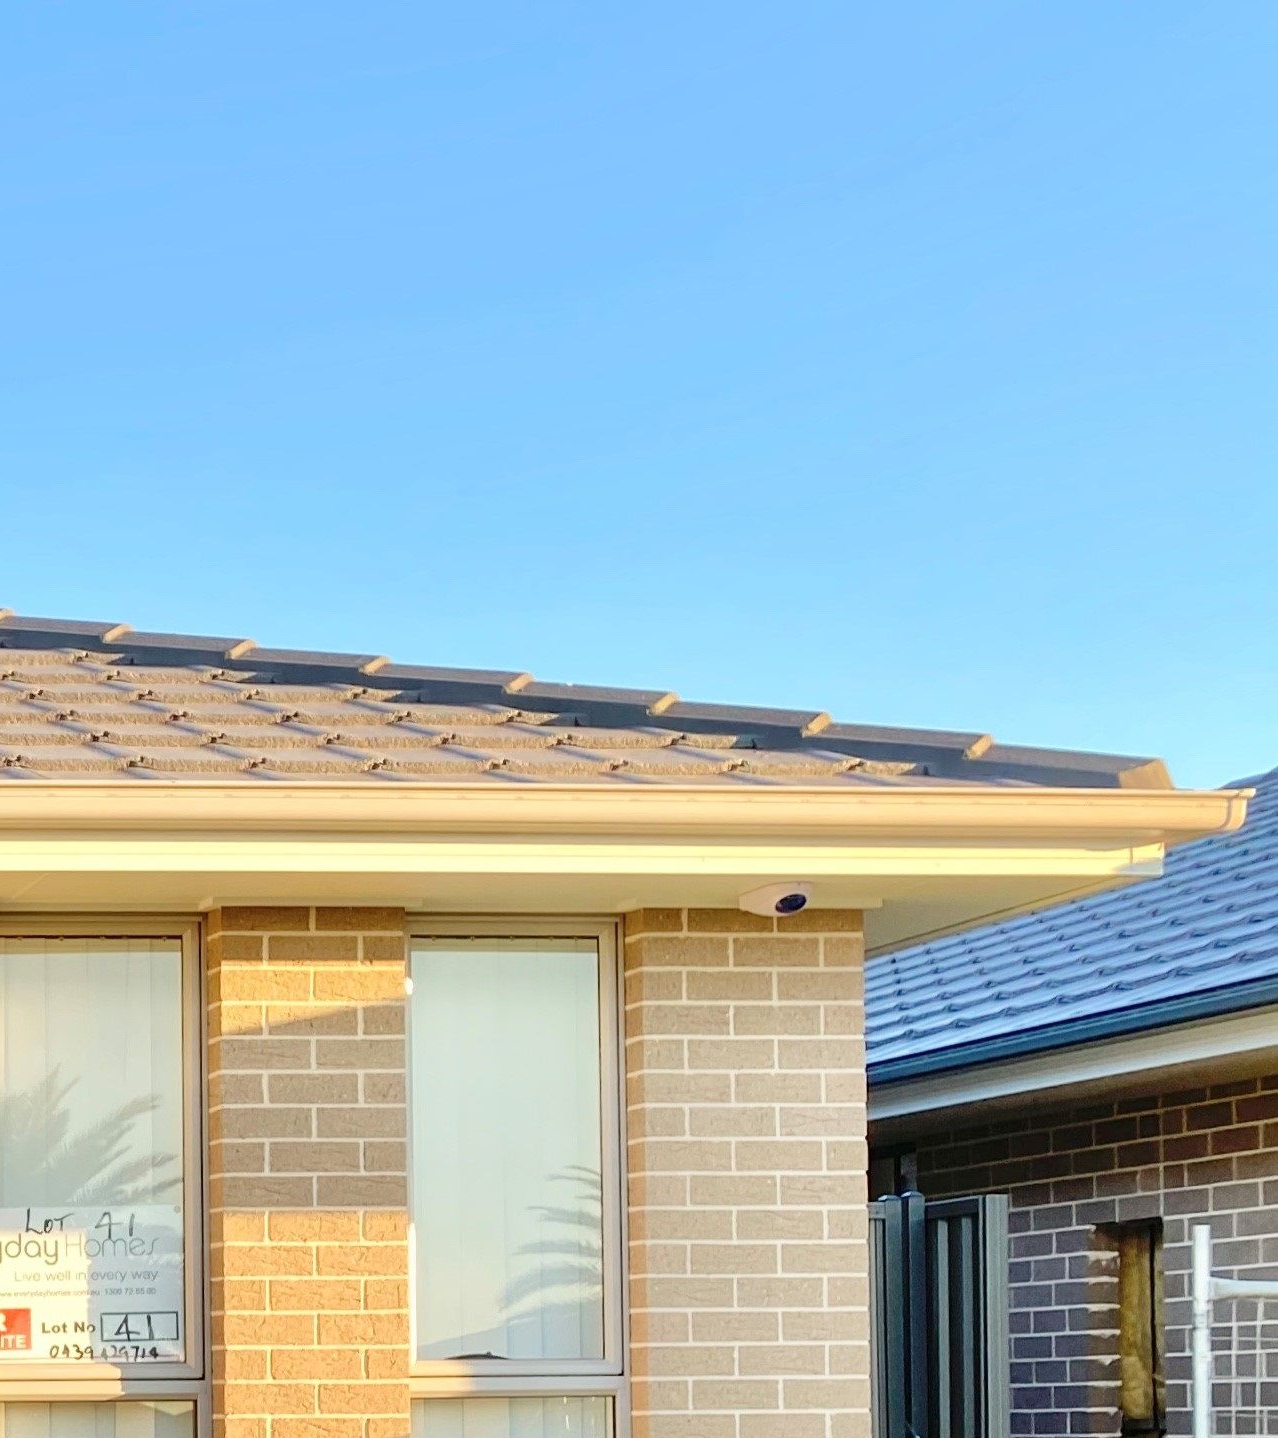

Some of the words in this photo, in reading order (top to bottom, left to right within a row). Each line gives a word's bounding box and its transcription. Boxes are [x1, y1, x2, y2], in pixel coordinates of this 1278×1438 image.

[95, 1211, 137, 1239] 41
[65, 1233, 160, 1257] Homes
[14, 1271, 40, 1282] Live
[45, 1270, 71, 1281] well
[75, 1270, 87, 1280] in
[90, 1270, 126, 1283] every
[131, 1269, 159, 1281] way
[42, 1322, 67, 1334] Lot
[74, 1322, 96, 1334] No
[114, 1313, 154, 1341] 41
